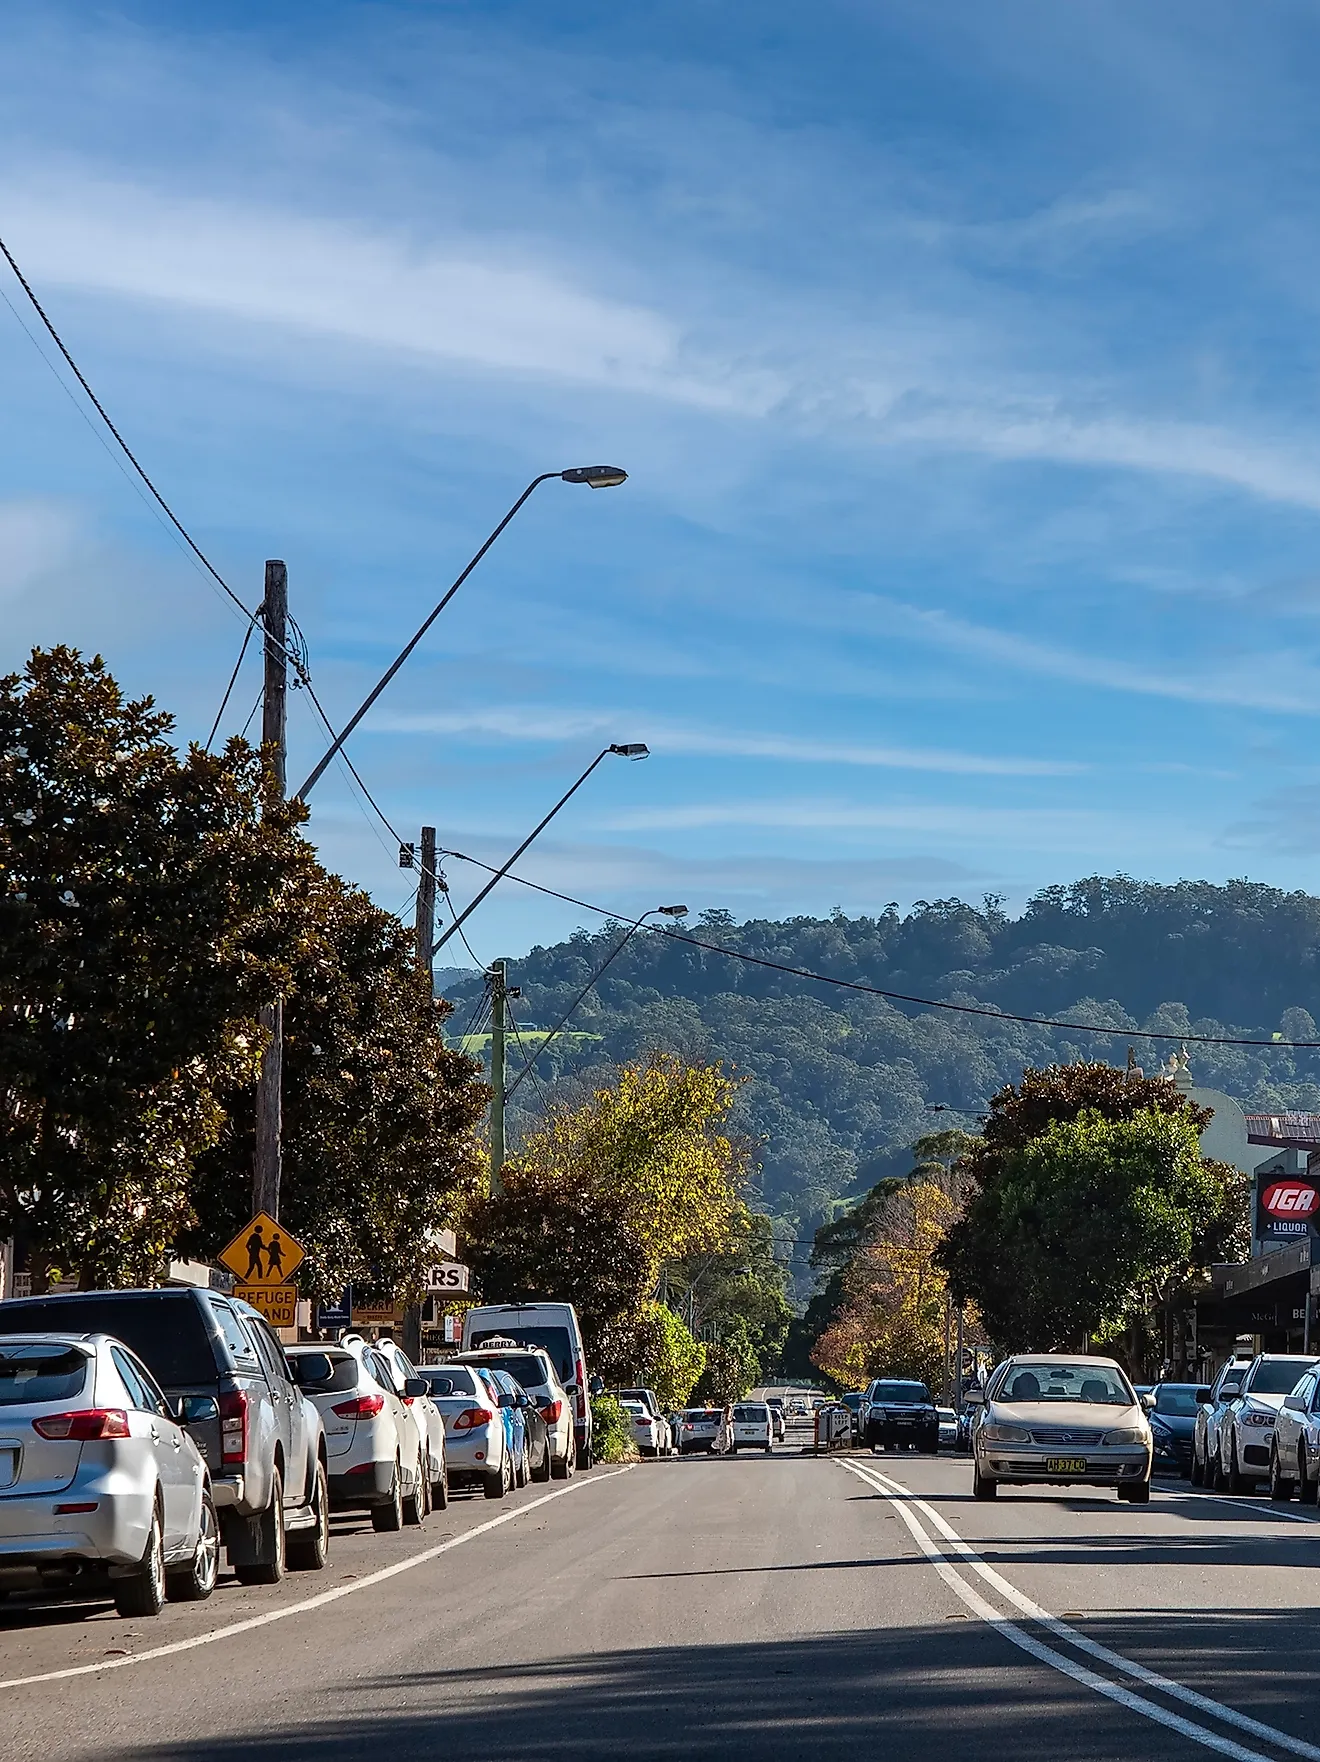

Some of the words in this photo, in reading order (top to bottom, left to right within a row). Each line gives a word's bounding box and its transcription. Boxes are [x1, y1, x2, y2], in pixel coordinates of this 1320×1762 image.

[1268, 1188, 1316, 1211] IGA
[1273, 1222, 1307, 1232] LIQUOR
[238, 1291, 292, 1304] REFUGE
[263, 1308, 291, 1320] AND
[482, 1340, 513, 1348] BERRY
